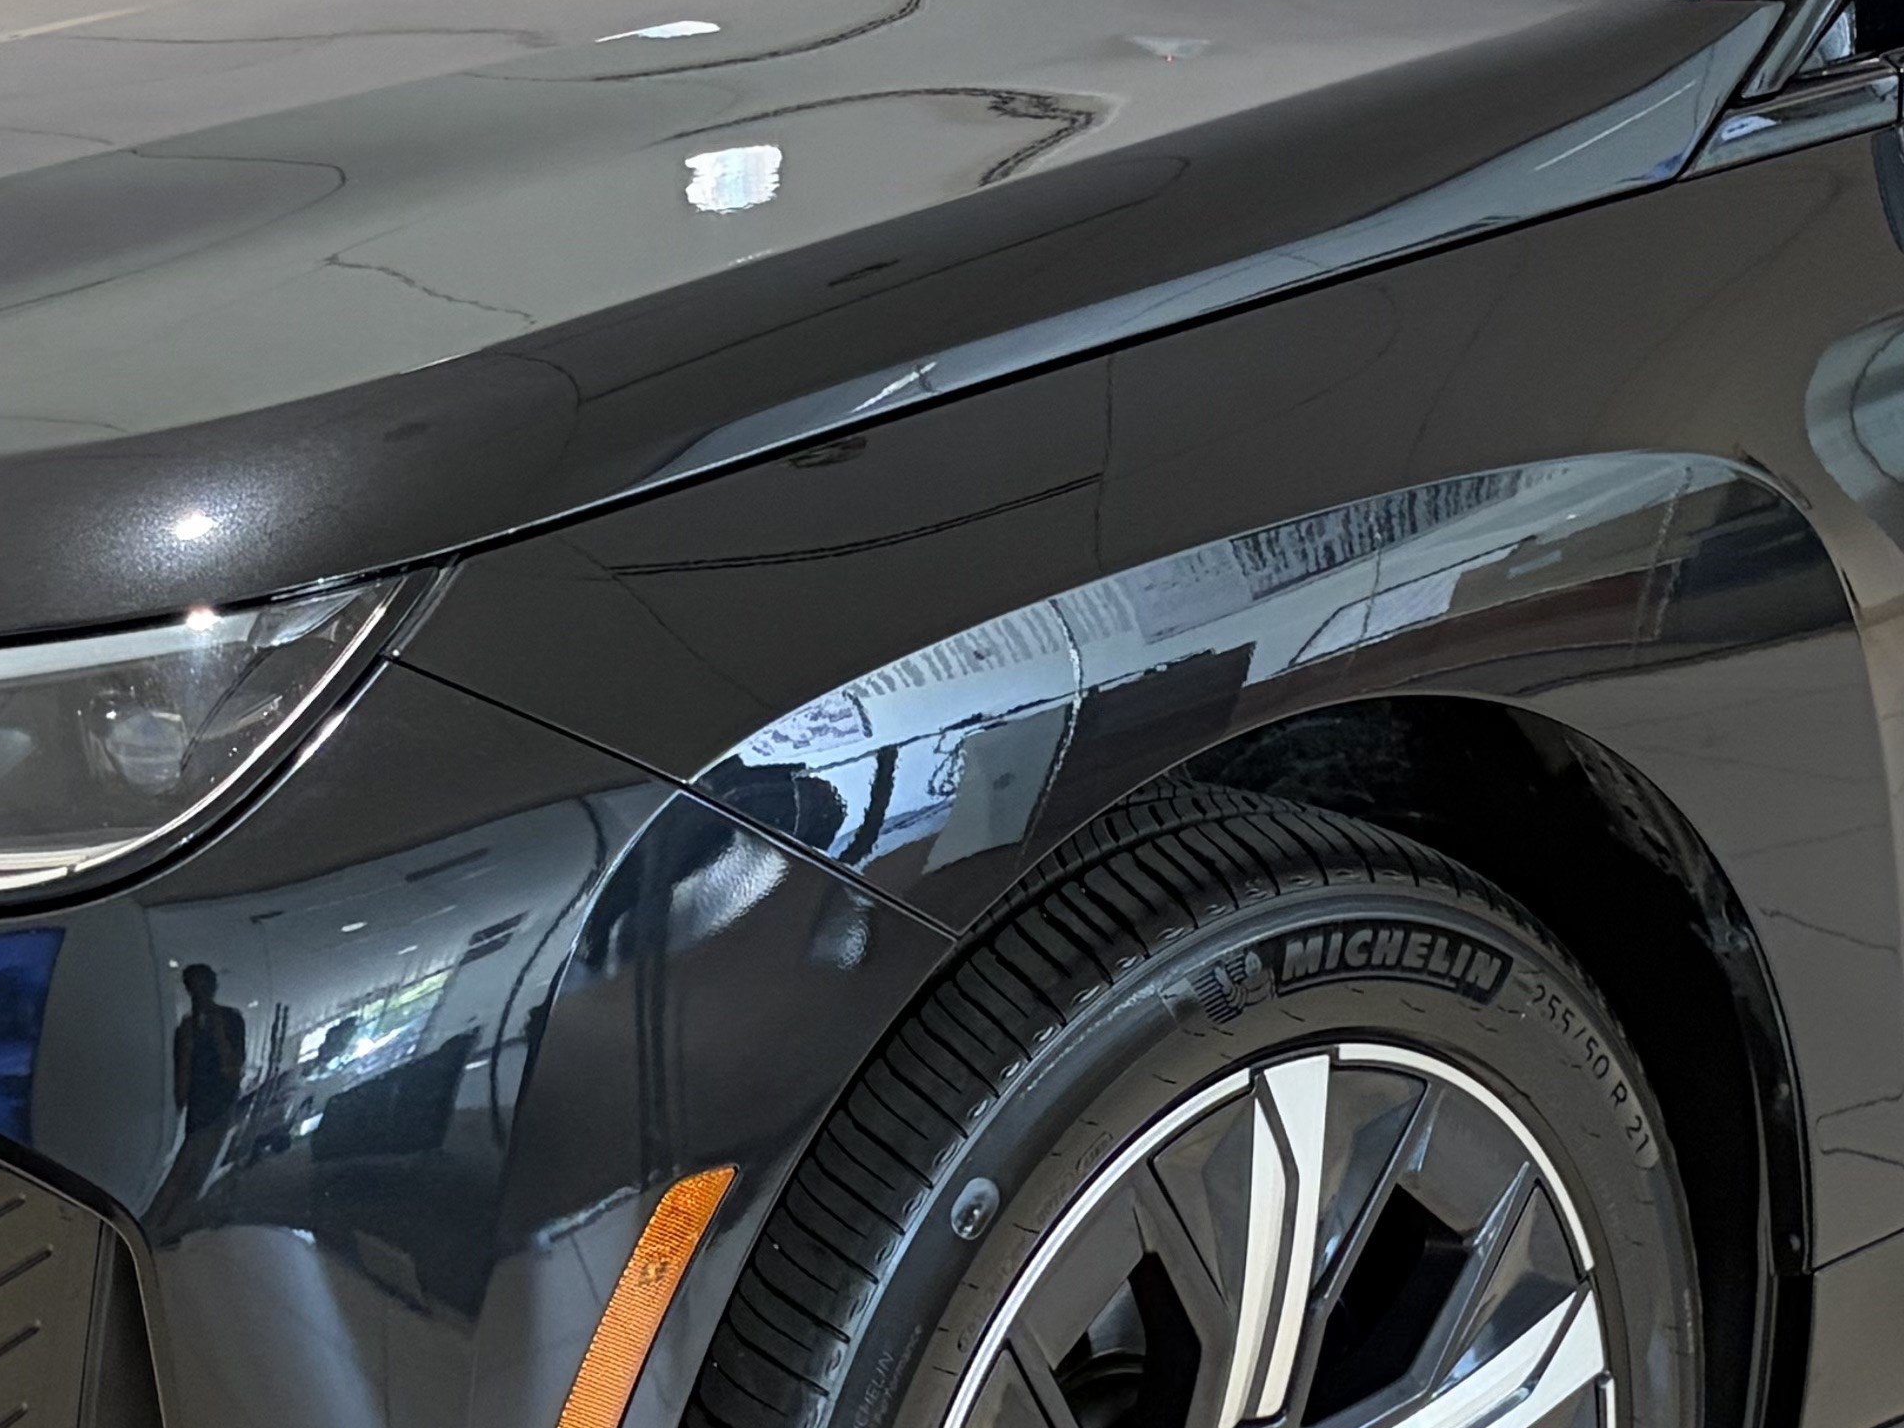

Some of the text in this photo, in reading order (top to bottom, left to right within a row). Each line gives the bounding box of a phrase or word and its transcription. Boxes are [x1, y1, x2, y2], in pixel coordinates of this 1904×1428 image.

[1281, 928, 1502, 993] MICHELIN
[1528, 983, 1650, 1154] 255/50 R 21
